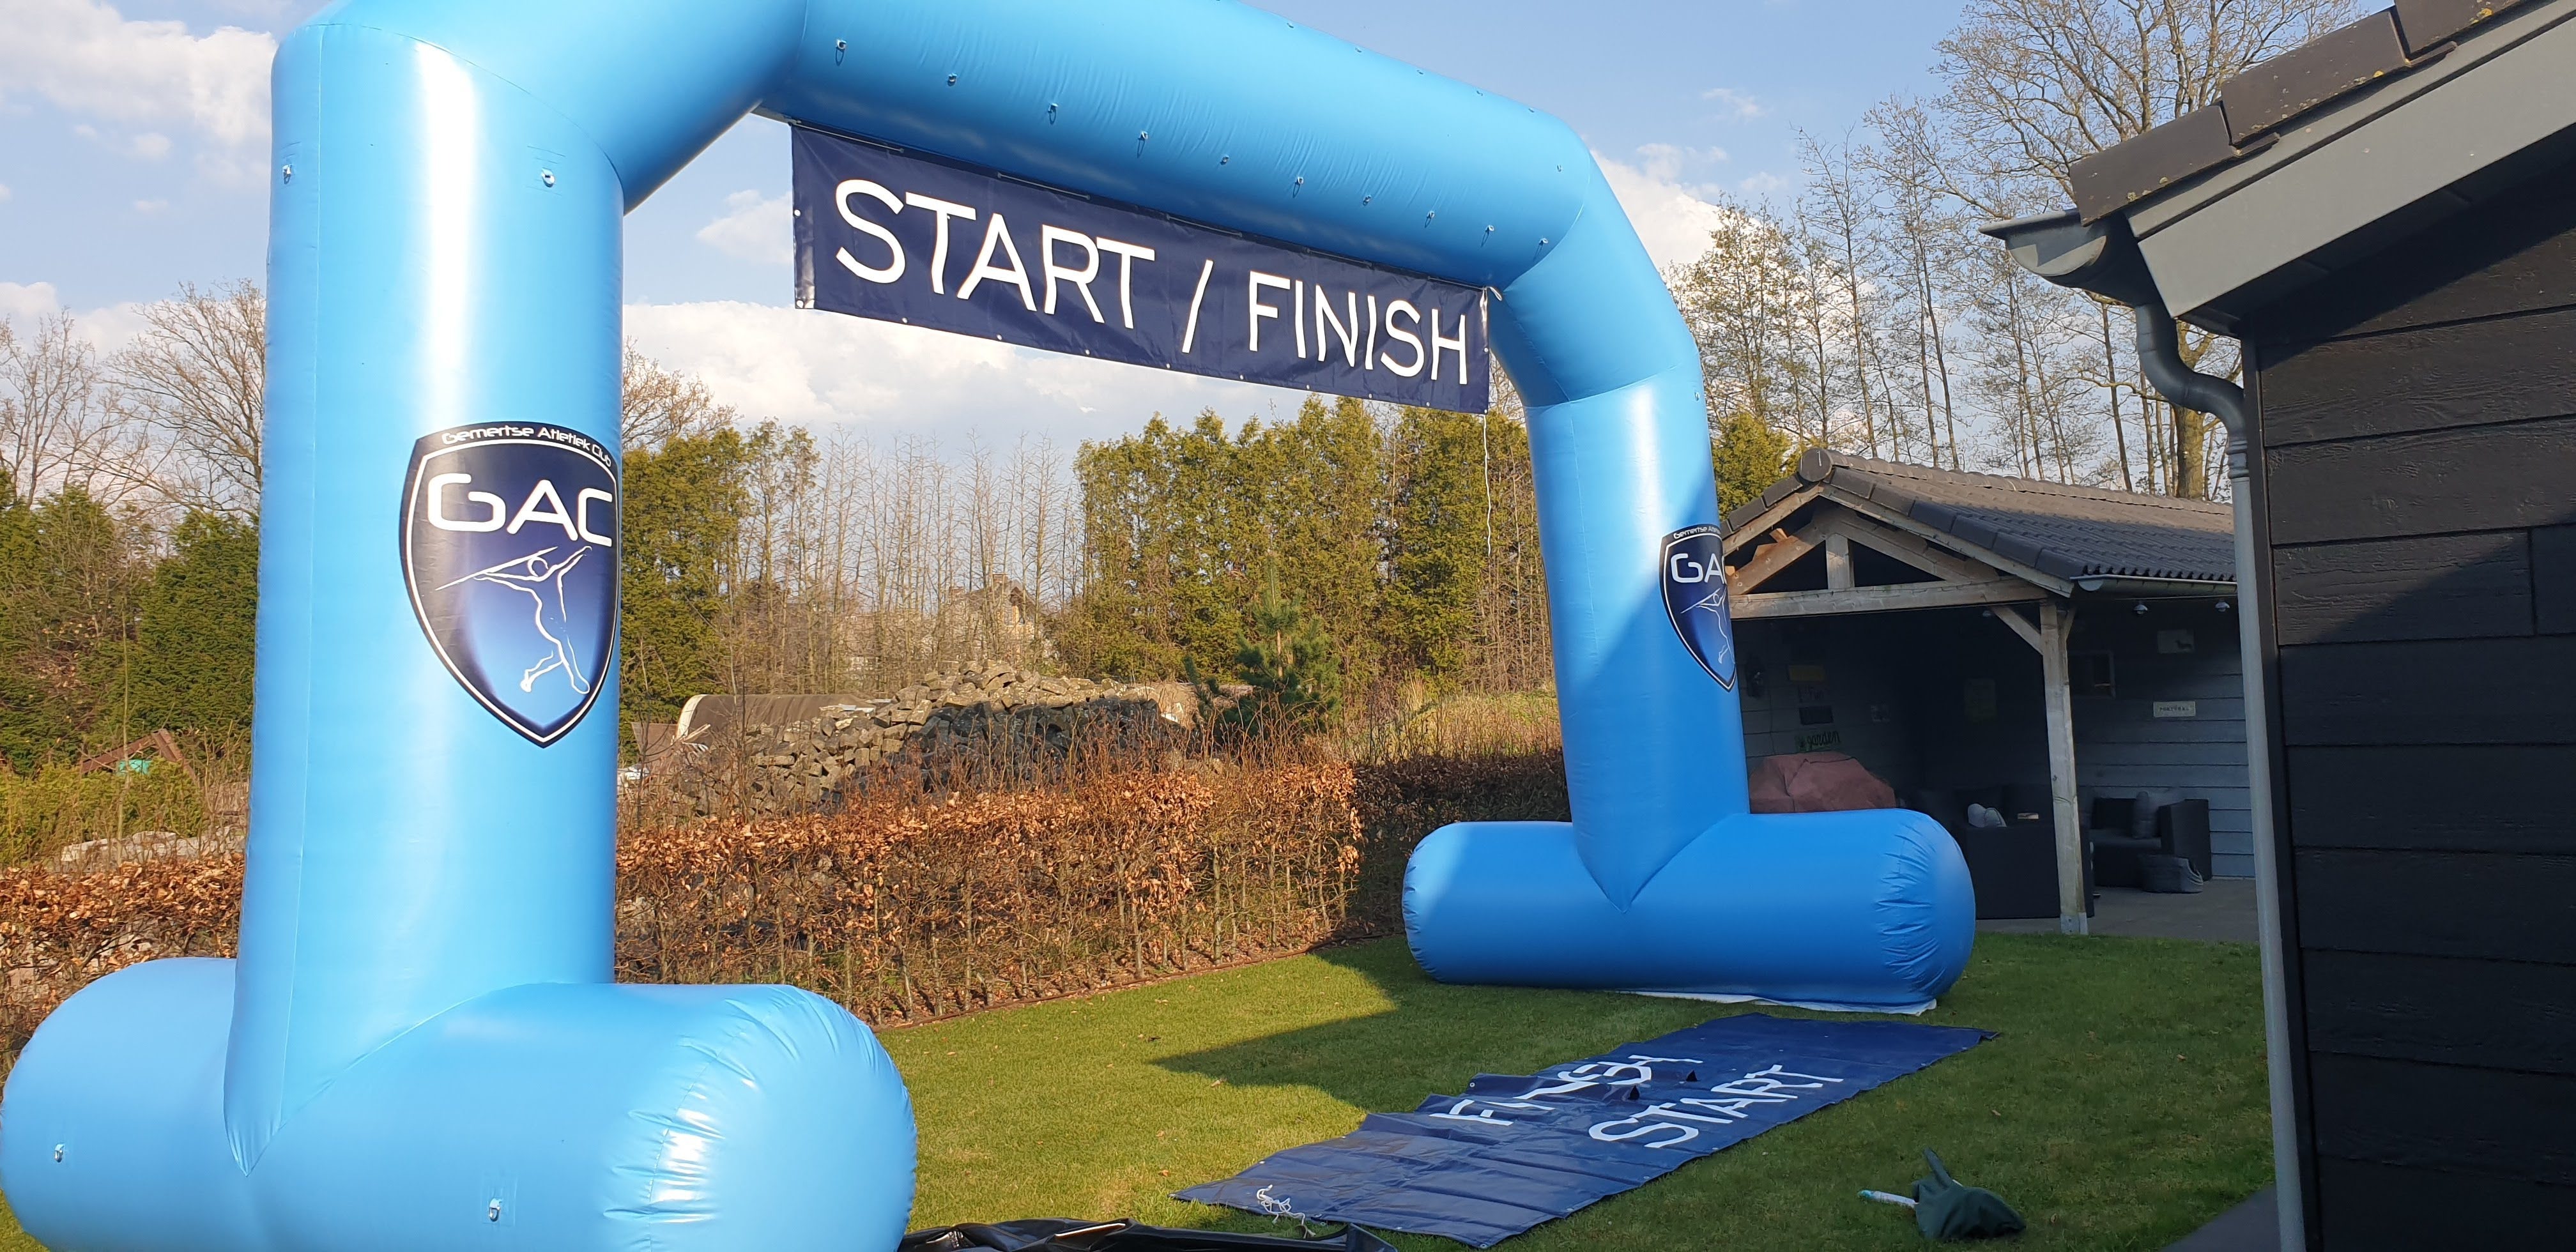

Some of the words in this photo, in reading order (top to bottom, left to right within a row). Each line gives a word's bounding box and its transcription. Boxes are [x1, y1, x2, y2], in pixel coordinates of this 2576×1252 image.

[834, 178, 1156, 330] START
[1181, 259, 1215, 354] /
[1248, 270, 1468, 385] FINISH
[441, 425, 534, 445] Gemertse
[537, 427, 591, 451] Atletiek
[592, 444, 612, 468] Club
[427, 473, 613, 547] GAC
[1670, 553, 1727, 584] GA
[1428, 1055, 1703, 1126] FINSH
[1588, 1064, 1843, 1149] START
